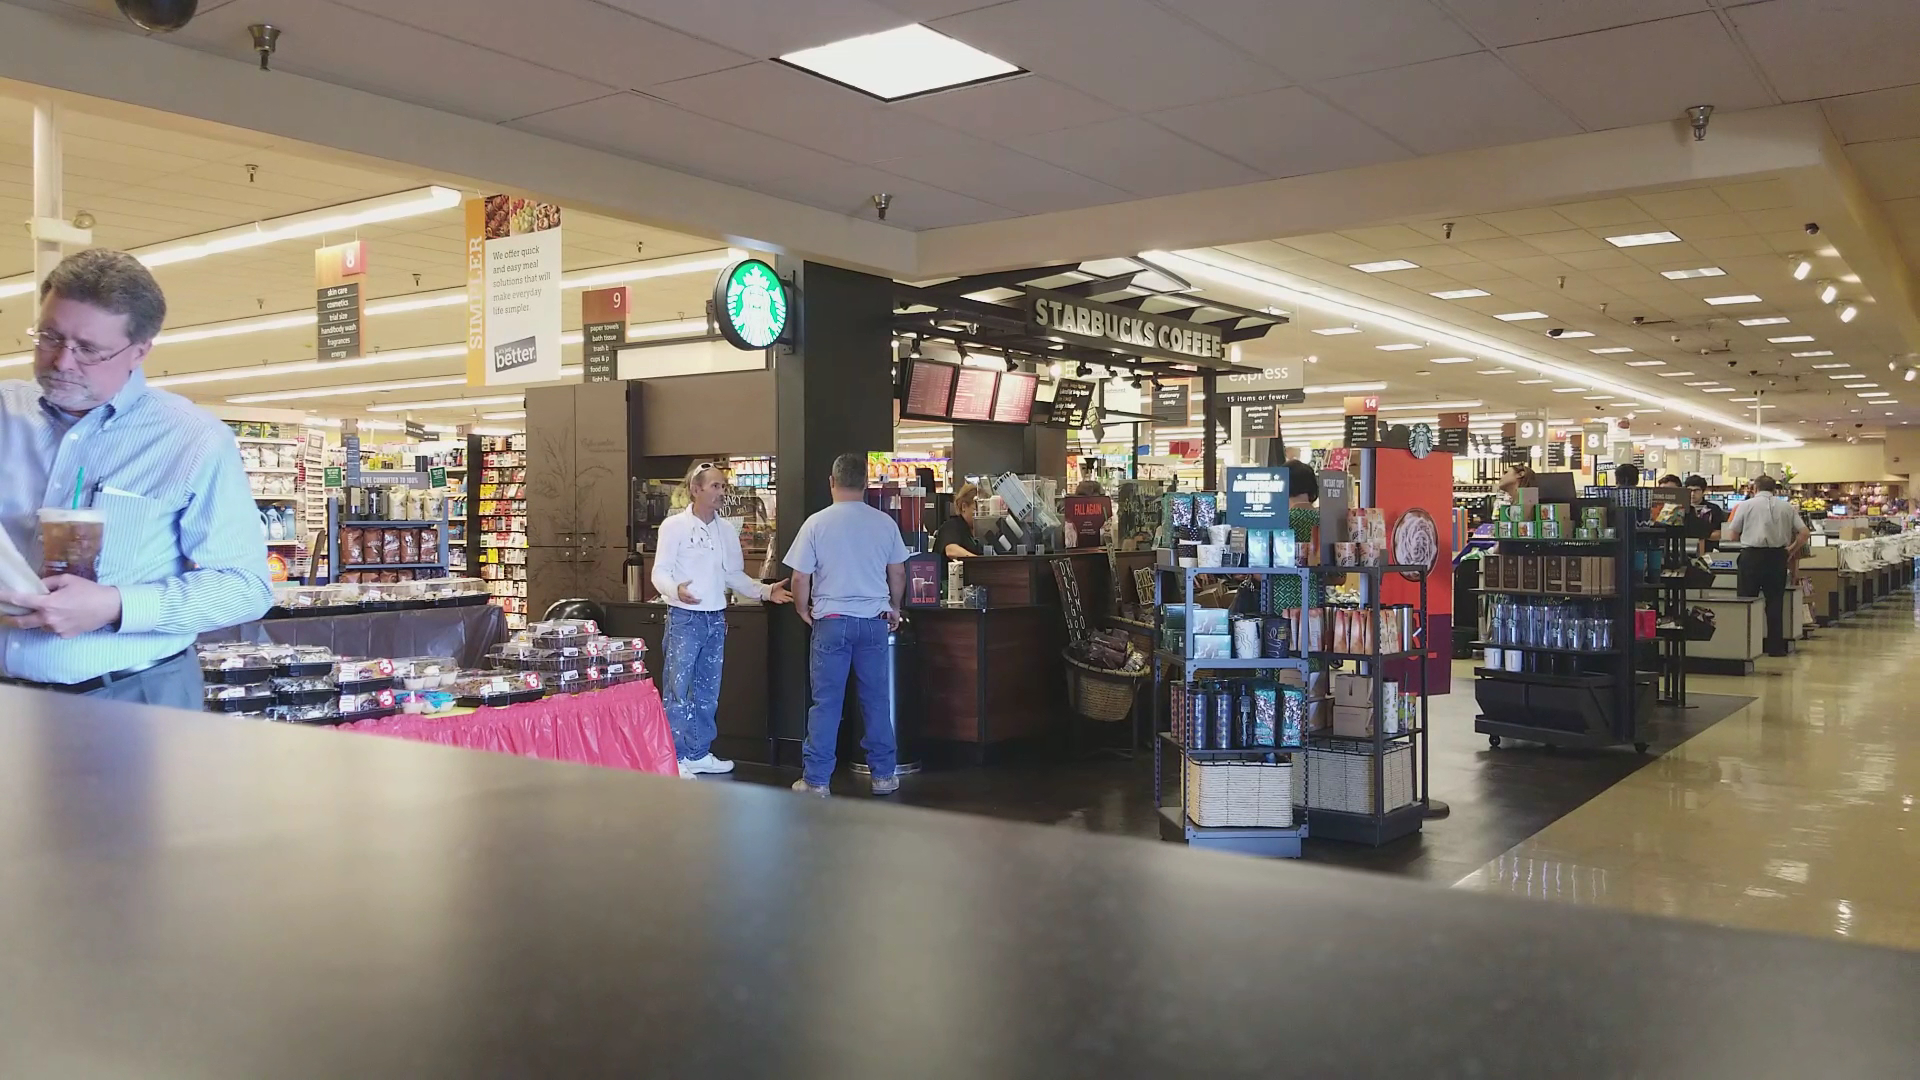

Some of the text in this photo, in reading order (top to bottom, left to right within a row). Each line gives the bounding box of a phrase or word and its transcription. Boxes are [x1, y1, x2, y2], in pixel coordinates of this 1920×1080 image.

[492, 245, 540, 260] We offer quick
[346, 249, 355, 268] 8
[493, 260, 539, 274] and easy meal
[493, 272, 551, 288] solutions that will
[338, 287, 348, 295] care
[469, 236, 482, 349] SIMPLER
[493, 288, 542, 302] make everyday
[326, 299, 349, 309] cosmetics
[613, 292, 621, 308] 9
[493, 306, 504, 315] life
[329, 312, 348, 321] trial size
[345, 323, 357, 332] wash
[590, 323, 620, 333] paper towels
[1035, 298, 1222, 358] STARBUCKS COFFEE
[327, 337, 351, 347] fragrances
[331, 350, 347, 359] energy
[1365, 399, 1376, 409] 14
[1458, 414, 1468, 422] 15
[1520, 422, 1534, 439] 9
[1588, 433, 1599, 448] 8
[1617, 447, 1625, 458] 7
[1648, 449, 1659, 463] 6
[1684, 454, 1692, 465] 5
[1708, 458, 1715, 469] 4
[1733, 462, 1740, 473] 3
[1336, 479, 1345, 488] CUPS
[1074, 503, 1102, 516] FALL AGAIN
[526, 674, 538, 687] $6
[380, 690, 393, 706] $5
